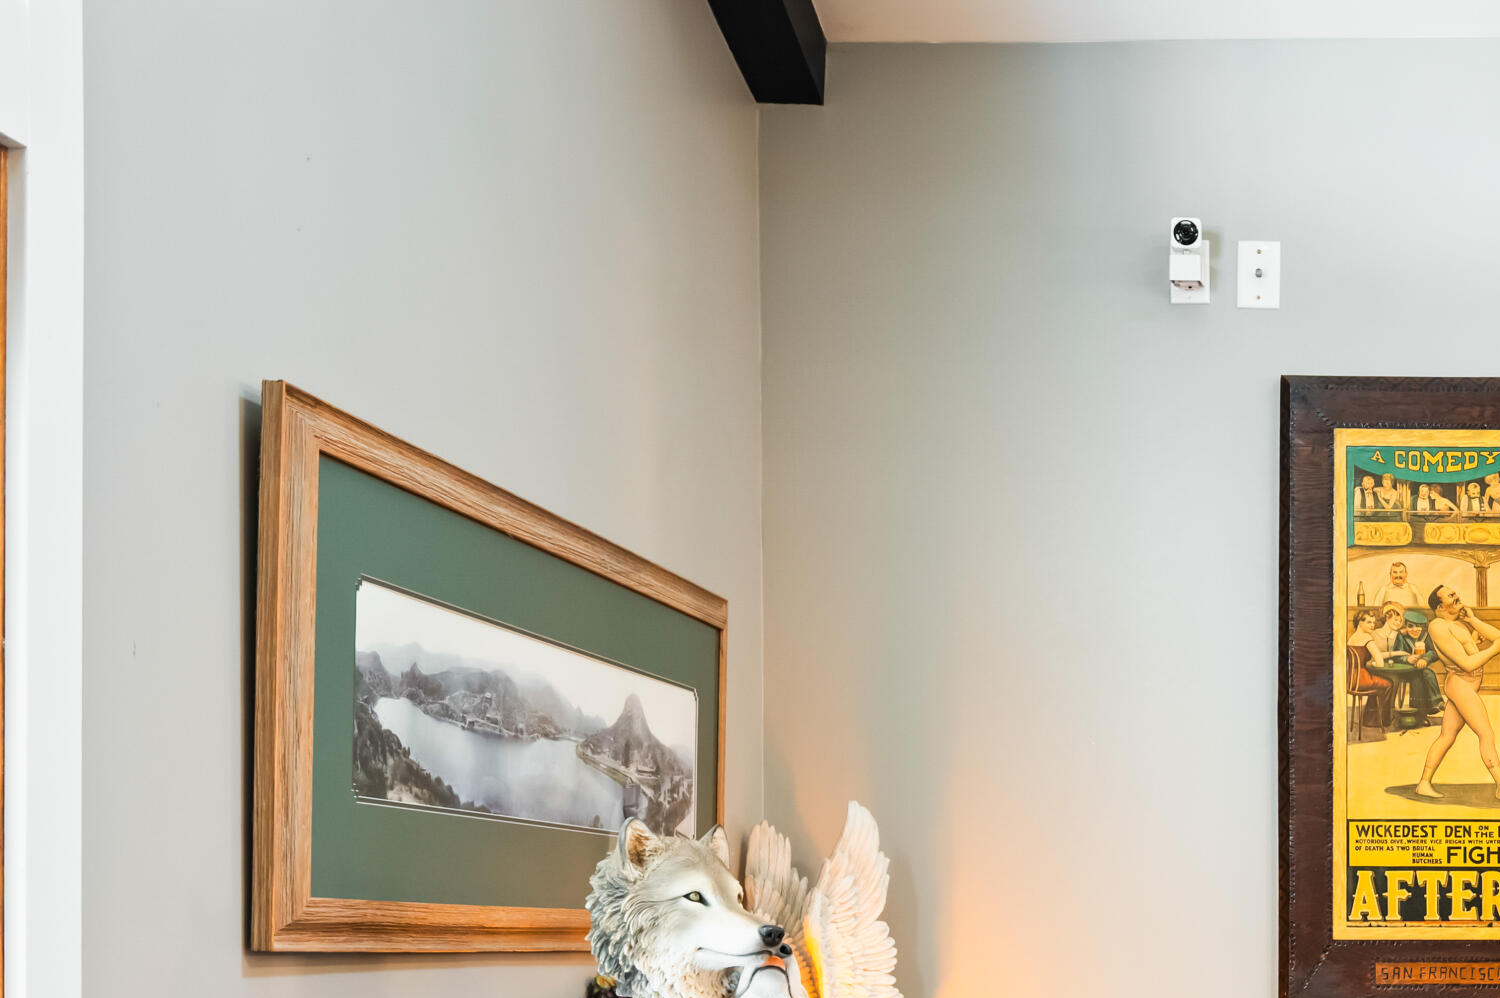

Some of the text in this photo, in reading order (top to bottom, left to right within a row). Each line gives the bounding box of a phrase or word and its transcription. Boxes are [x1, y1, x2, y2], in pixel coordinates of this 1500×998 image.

[1370, 450, 1385, 464] A
[1394, 450, 1500, 473] COMEDY
[1355, 824, 1472, 838] WICKEDEST DEN
[1380, 966, 1413, 981] SAN
